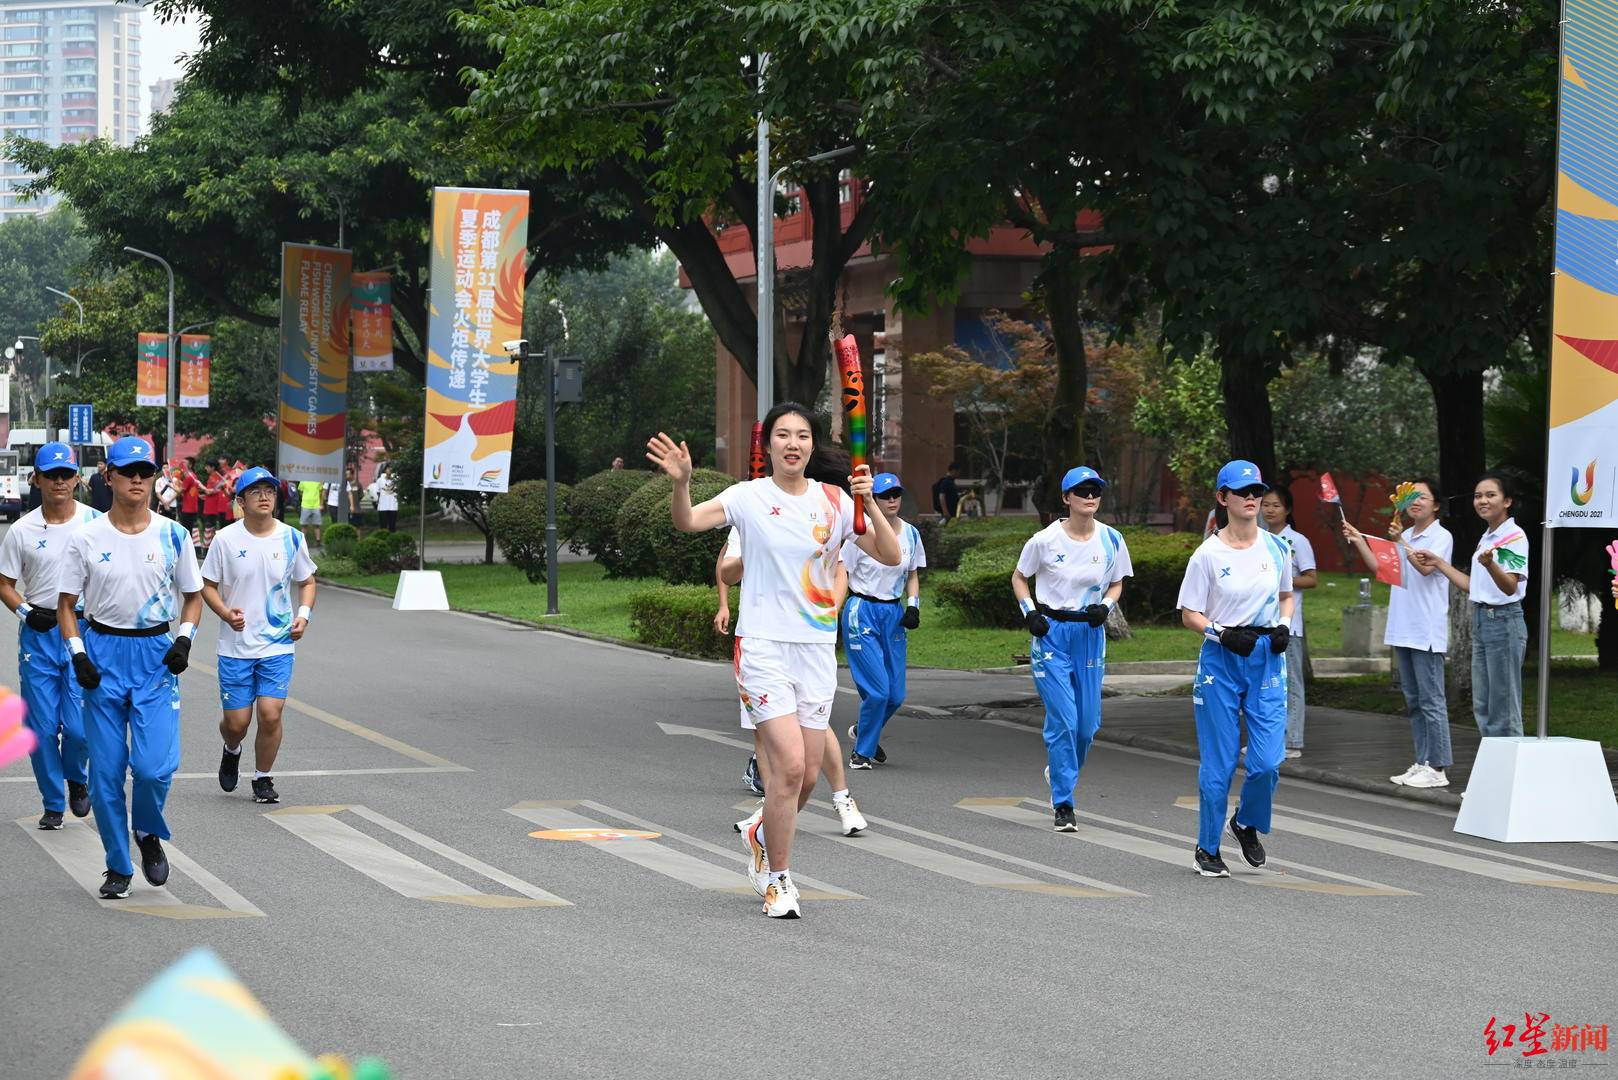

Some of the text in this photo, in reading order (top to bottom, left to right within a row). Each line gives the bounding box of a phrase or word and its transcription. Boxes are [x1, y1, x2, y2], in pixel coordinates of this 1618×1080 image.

[298, 260, 311, 334] FLAME RELAY
[307, 261, 322, 435] FISU WORLD UNIVERSITY GAMES
[322, 263, 333, 317] CHENGDU
[449, 208, 479, 389] 夏季运动会火炬传递
[468, 209, 501, 409] 成都第31届世界大学生
[1558, 510, 1603, 518] CHENGDU 2021
